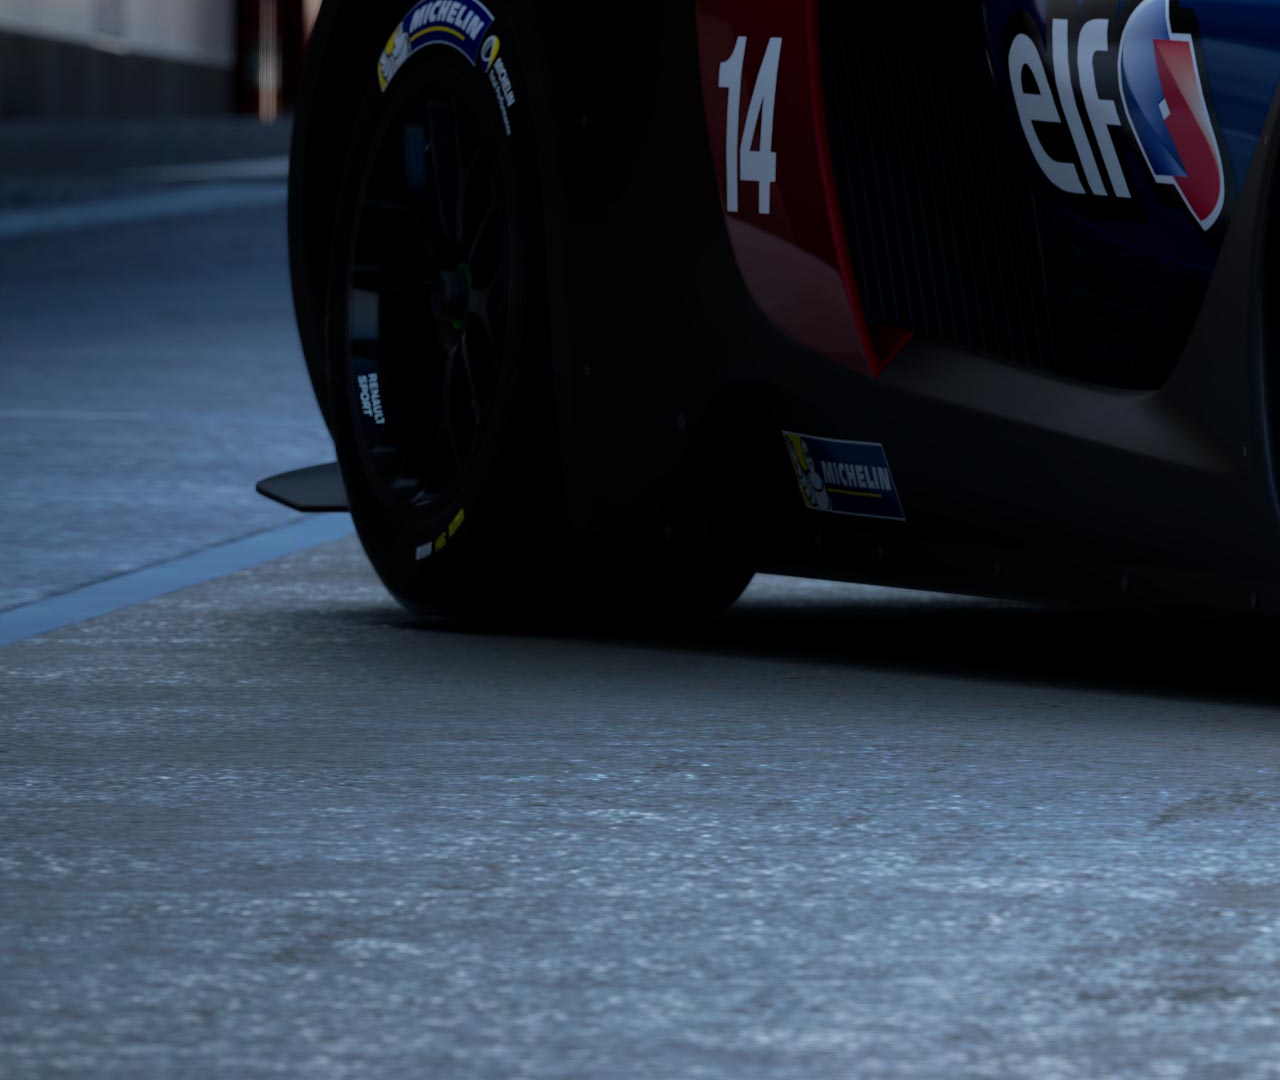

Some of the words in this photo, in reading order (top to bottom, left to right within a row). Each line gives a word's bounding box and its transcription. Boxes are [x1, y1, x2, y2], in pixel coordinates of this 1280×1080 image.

[718, 35, 783, 215] 14
[1007, 17, 1132, 199] elf
[357, 374, 373, 417] SPORT
[368, 372, 386, 424] RENAULT
[820, 460, 892, 491] MICHELIN
